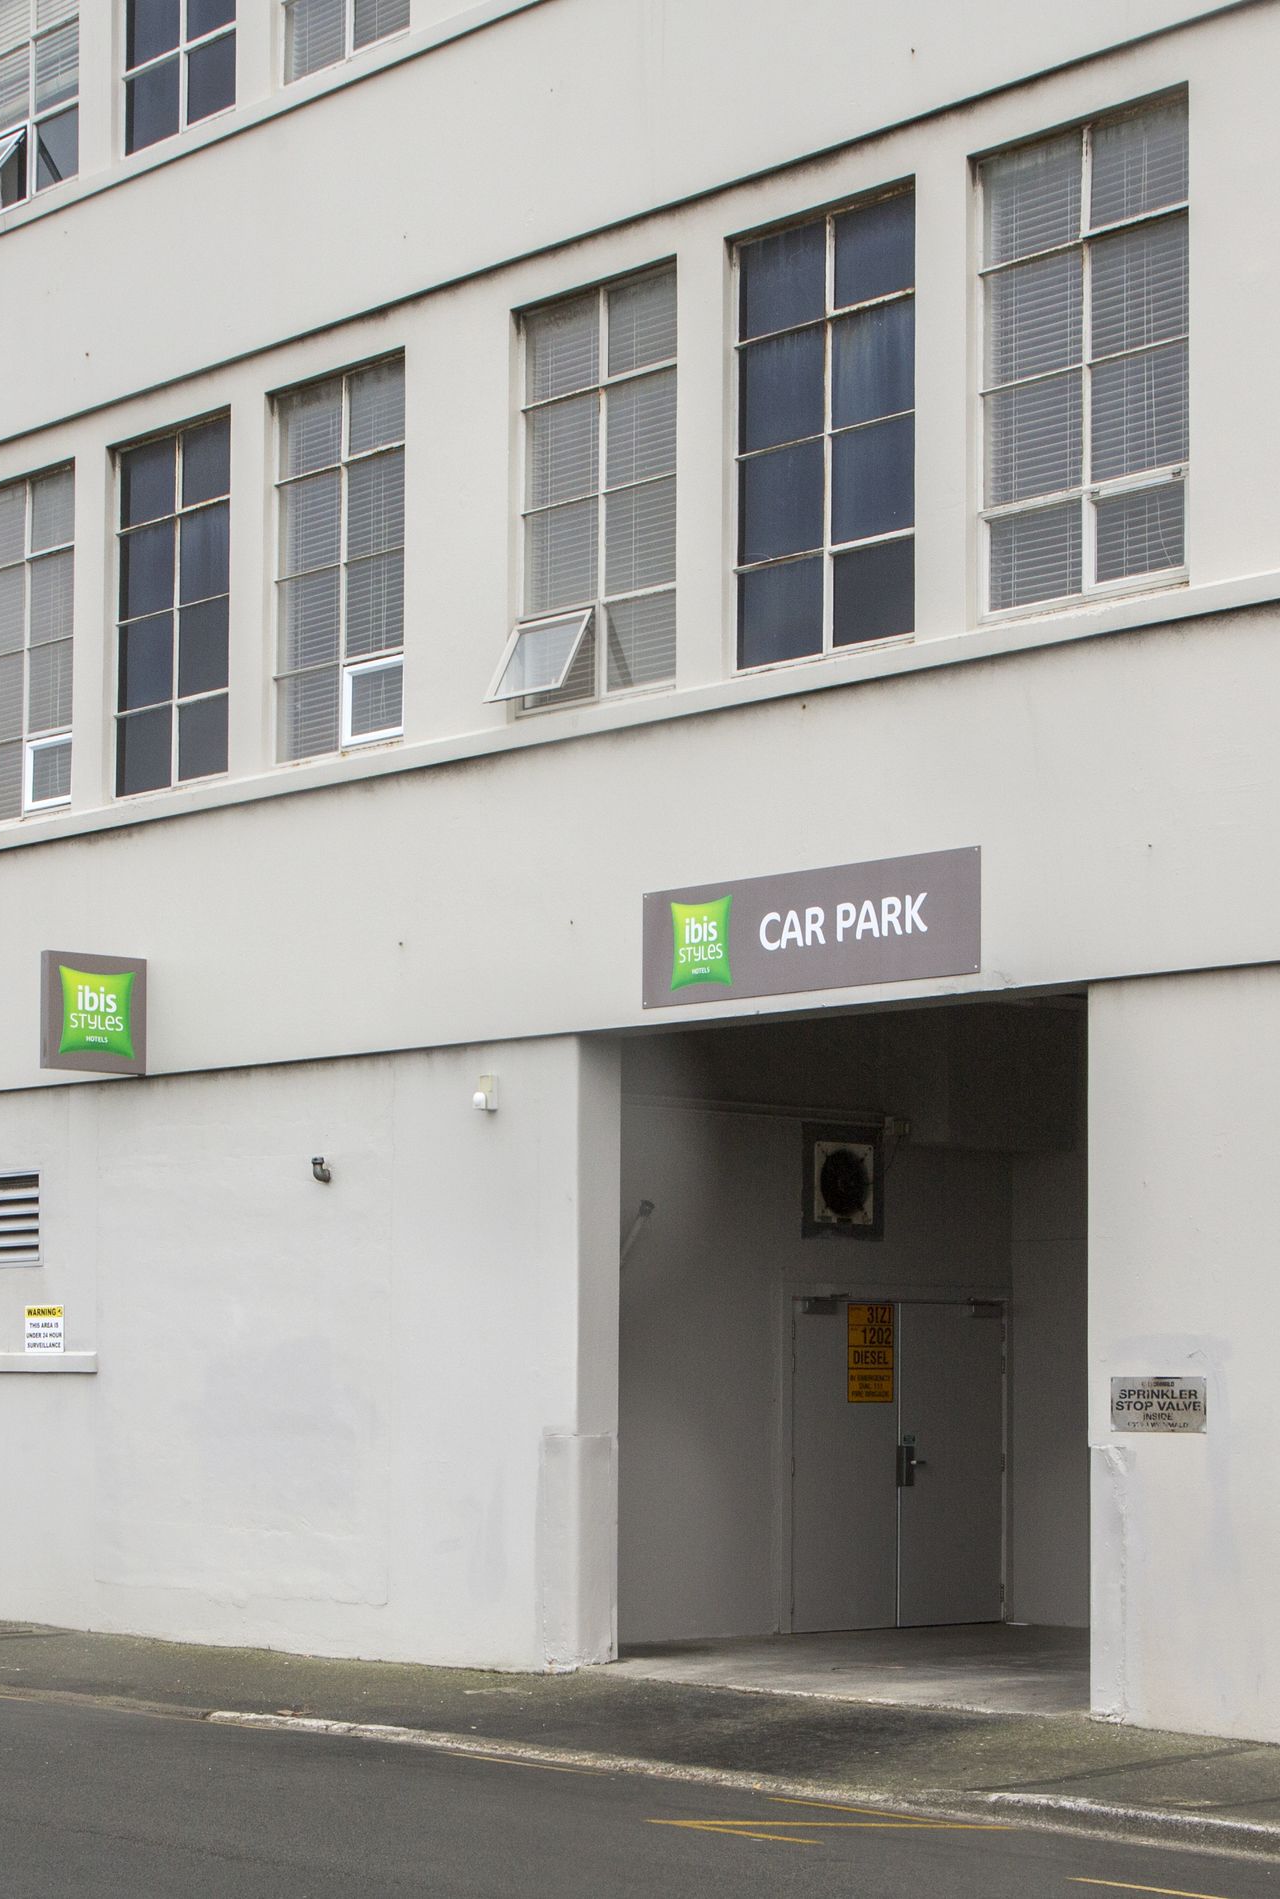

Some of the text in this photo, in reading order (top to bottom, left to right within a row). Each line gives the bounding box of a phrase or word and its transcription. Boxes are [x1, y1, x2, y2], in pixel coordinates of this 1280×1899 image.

[759, 892, 928, 950] CAR PARK
[685, 916, 718, 944] ibis
[691, 966, 710, 975] HOTELS
[77, 985, 117, 1013] ibis
[85, 1035, 108, 1043] HOTELS
[27, 1308, 57, 1316] WARNING
[862, 1327, 892, 1344] 1202
[853, 1350, 888, 1365] DIESEL
[1119, 1389, 1198, 1400] SPRINKLER
[1115, 1401, 1201, 1411] STOP VALVE
[1143, 1412, 1174, 1420] INSIDE
